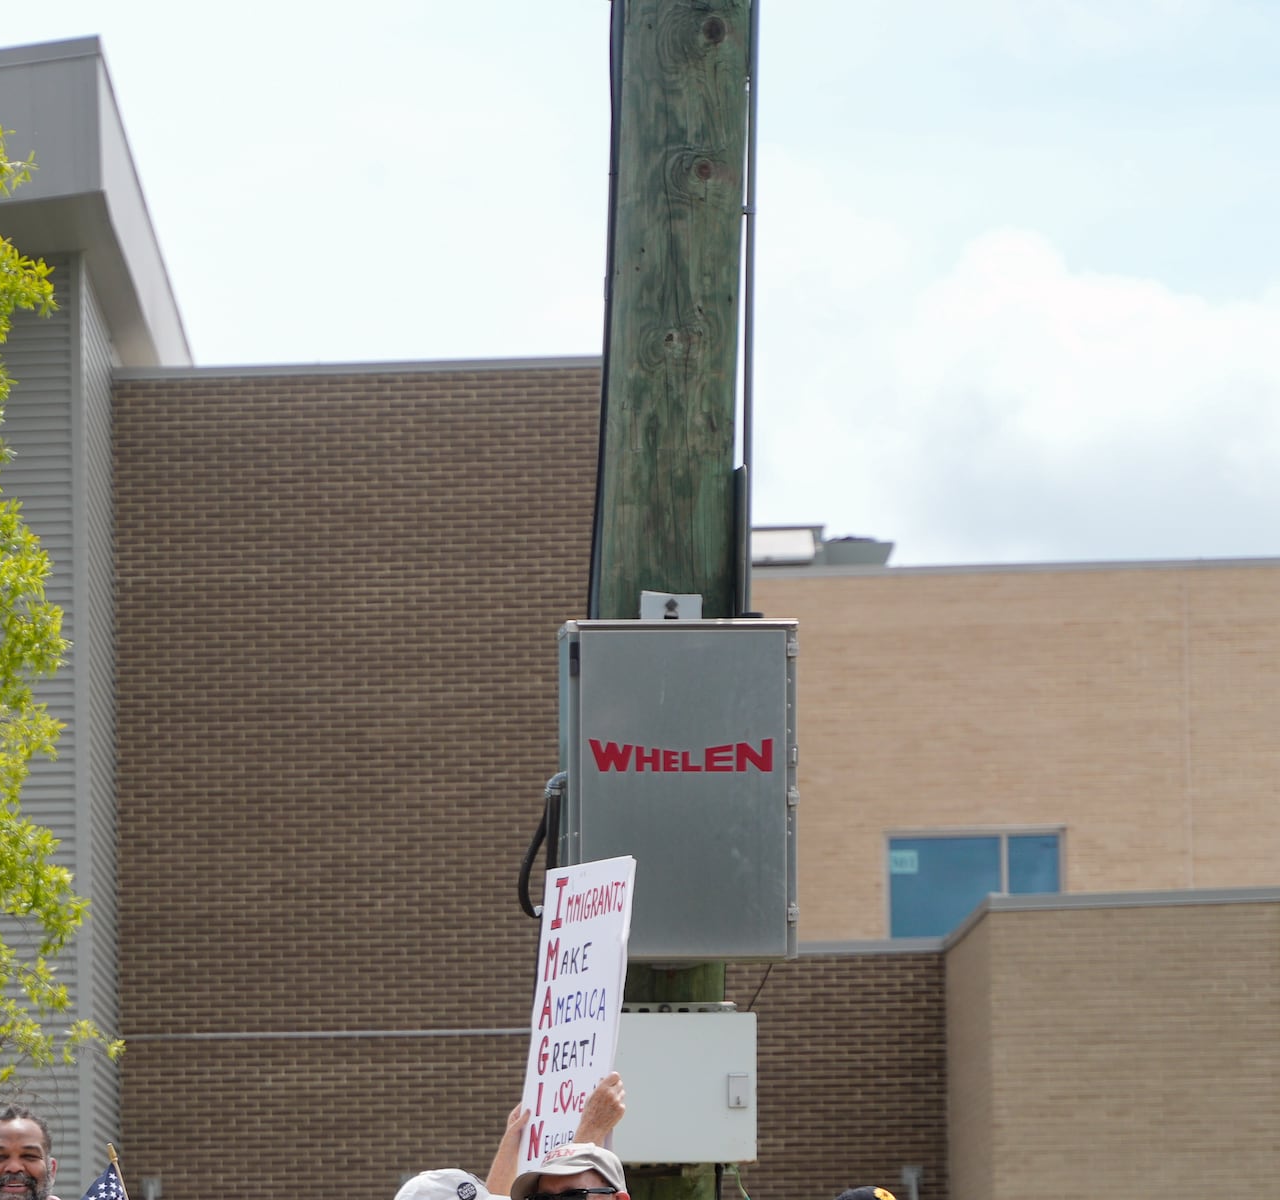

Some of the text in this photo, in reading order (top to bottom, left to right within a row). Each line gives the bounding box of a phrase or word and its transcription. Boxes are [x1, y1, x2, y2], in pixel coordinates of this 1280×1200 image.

[588, 738, 773, 772] WHELEN
[550, 876, 626, 931] IMMIGRANTS
[544, 937, 593, 982] MAKE
[538, 986, 606, 1030] AMERICA
[537, 1033, 596, 1076] GREAT!
